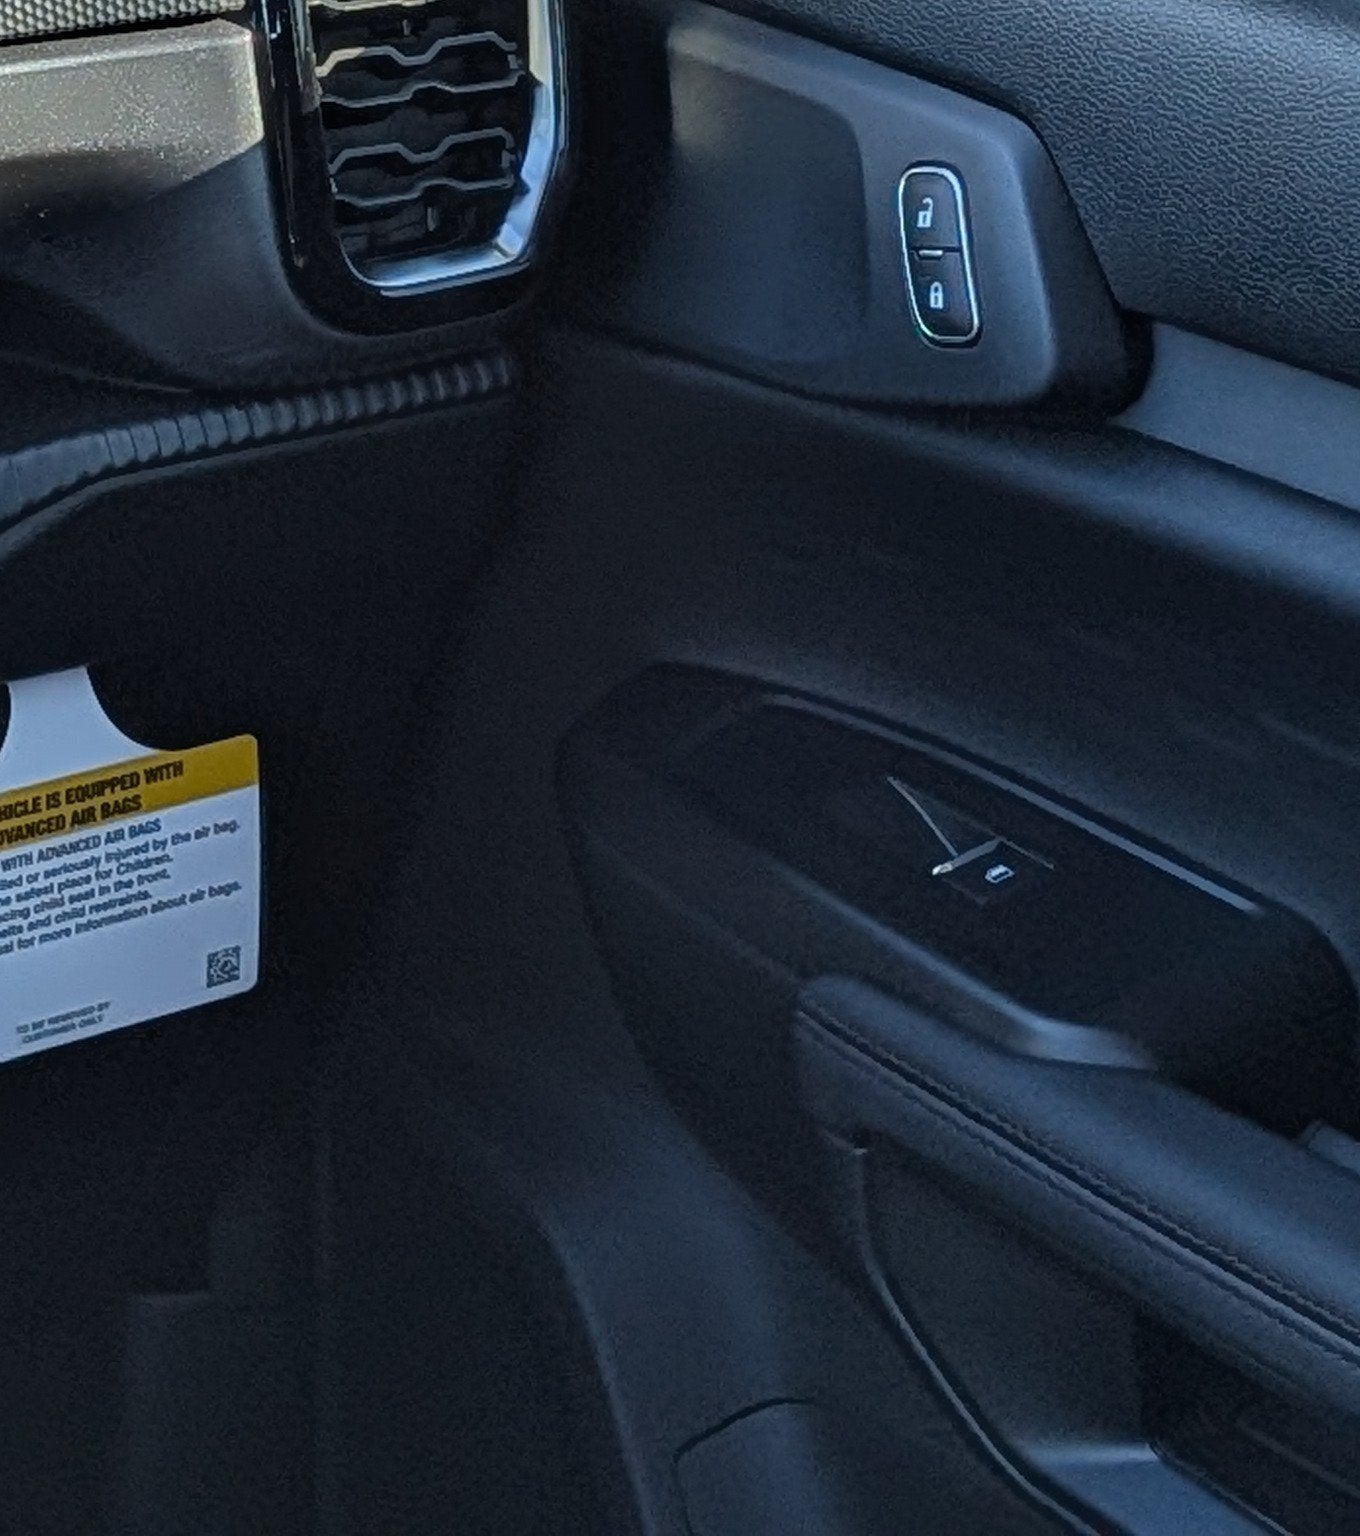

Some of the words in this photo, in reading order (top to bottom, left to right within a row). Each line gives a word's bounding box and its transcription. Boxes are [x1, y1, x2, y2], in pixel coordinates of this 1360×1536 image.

[45, 790, 61, 810] IS
[64, 770, 140, 804] EQUIPPED
[143, 760, 183, 784] WITH
[69, 805, 97, 828] AIR
[100, 794, 142, 819] BAGS
[0, 851, 33, 872] WITH
[36, 834, 101, 863] ADVANCED
[104, 827, 125, 845] AIR
[128, 817, 161, 839] BAGS
[25, 872, 39, 884] or
[43, 855, 101, 880] seriously
[104, 840, 149, 863] injured
[151, 837, 167, 851] by
[170, 831, 191, 846] the
[194, 825, 210, 840] air
[213, 819, 240, 835] bag.
[15, 881, 54, 903] safest
[56, 873, 92, 894] place
[94, 867, 112, 881] for
[33, 894, 65, 914] child
[67, 887, 95, 904] seat
[97, 884, 111, 896] in
[113, 878, 134, 892] the
[16, 935, 36, 950] for
[38, 927, 71, 943] more
[74, 905, 148, 934] information
[149, 893, 187, 914] about
[188, 888, 206, 903] air
[26, 914, 51, 932] and
[53, 904, 86, 924] child
